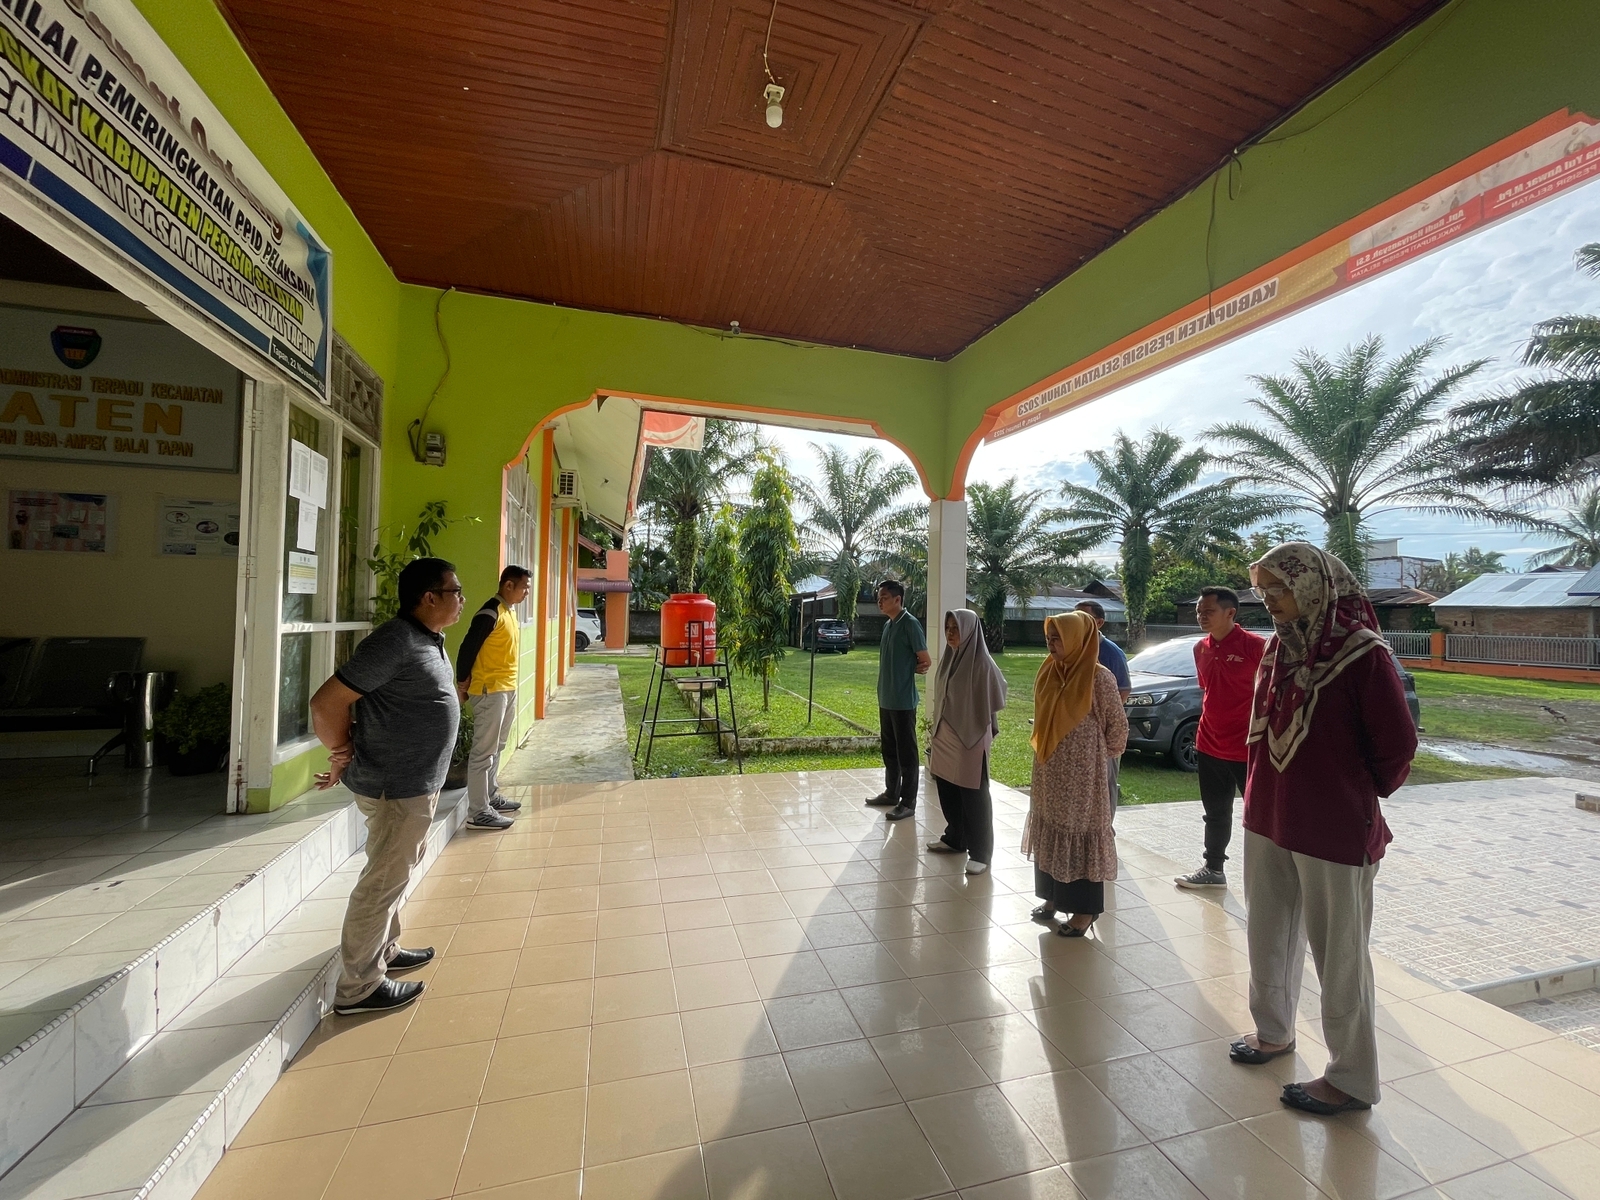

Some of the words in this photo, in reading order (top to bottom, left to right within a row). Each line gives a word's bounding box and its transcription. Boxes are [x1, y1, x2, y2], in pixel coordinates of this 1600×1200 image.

[0, 24, 78, 124] GKAT
[79, 100, 201, 232] KABUPATEN
[201, 215, 254, 284] PESISIR
[253, 265, 304, 324] SELATAN
[2, 0, 79, 66] ILAI
[81, 53, 235, 219] PEMERINGKATAN
[235, 207, 263, 250] PPID
[263, 241, 316, 304] PELAKSANA
[126, 188, 184, 259] BASA
[184, 235, 245, 307] AMPEK
[244, 285, 284, 338] BALAI
[283, 319, 316, 362] TAPAN
[89, 376, 144, 397] TERPADU
[151, 382, 223, 404] KECAMATAN
[113, 436, 148, 454] BALAI
[157, 439, 193, 457] TAPAN
